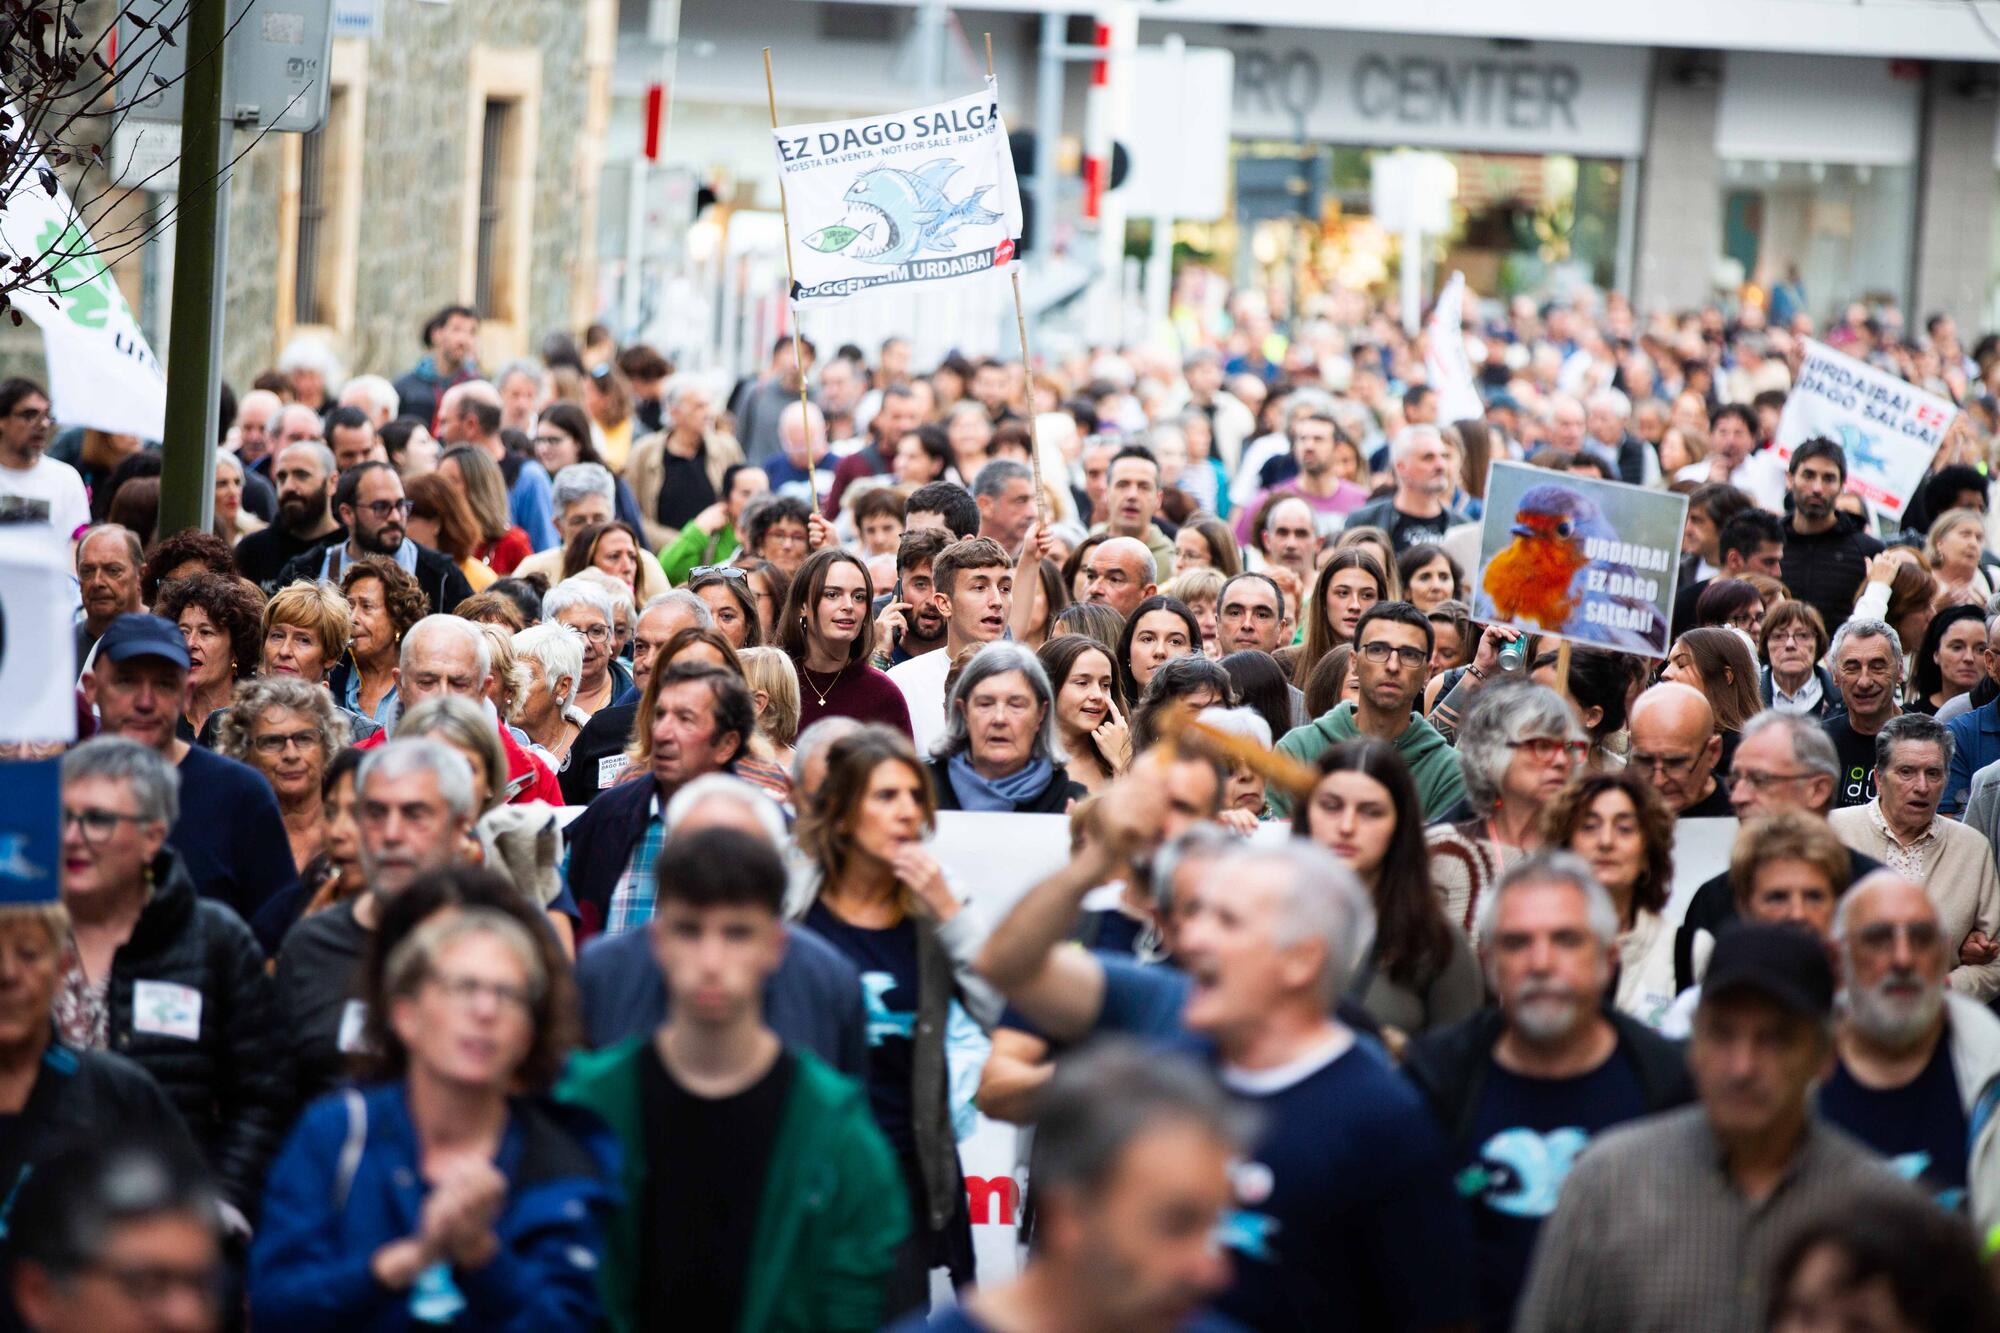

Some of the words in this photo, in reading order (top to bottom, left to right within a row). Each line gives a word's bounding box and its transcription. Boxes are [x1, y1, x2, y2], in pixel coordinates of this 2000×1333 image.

[1351, 53, 1580, 130] CENTER
[777, 136, 812, 162] EZ
[819, 122, 905, 155] DAGO
[825, 157, 838, 166] EN
[840, 150, 874, 162] VENTA
[881, 144, 901, 156] NOT
[905, 141, 925, 152] FOR
[928, 137, 951, 149] SALE
[958, 134, 974, 144] PAS
[912, 251, 991, 279] URDAIBAI
[1801, 374, 1856, 411] DAGO
[1917, 403, 1945, 428] EZ
[1585, 537, 1670, 573] URDAIBAI
[1588, 569, 1607, 593] EZ
[1608, 573, 1658, 602] DAGO
